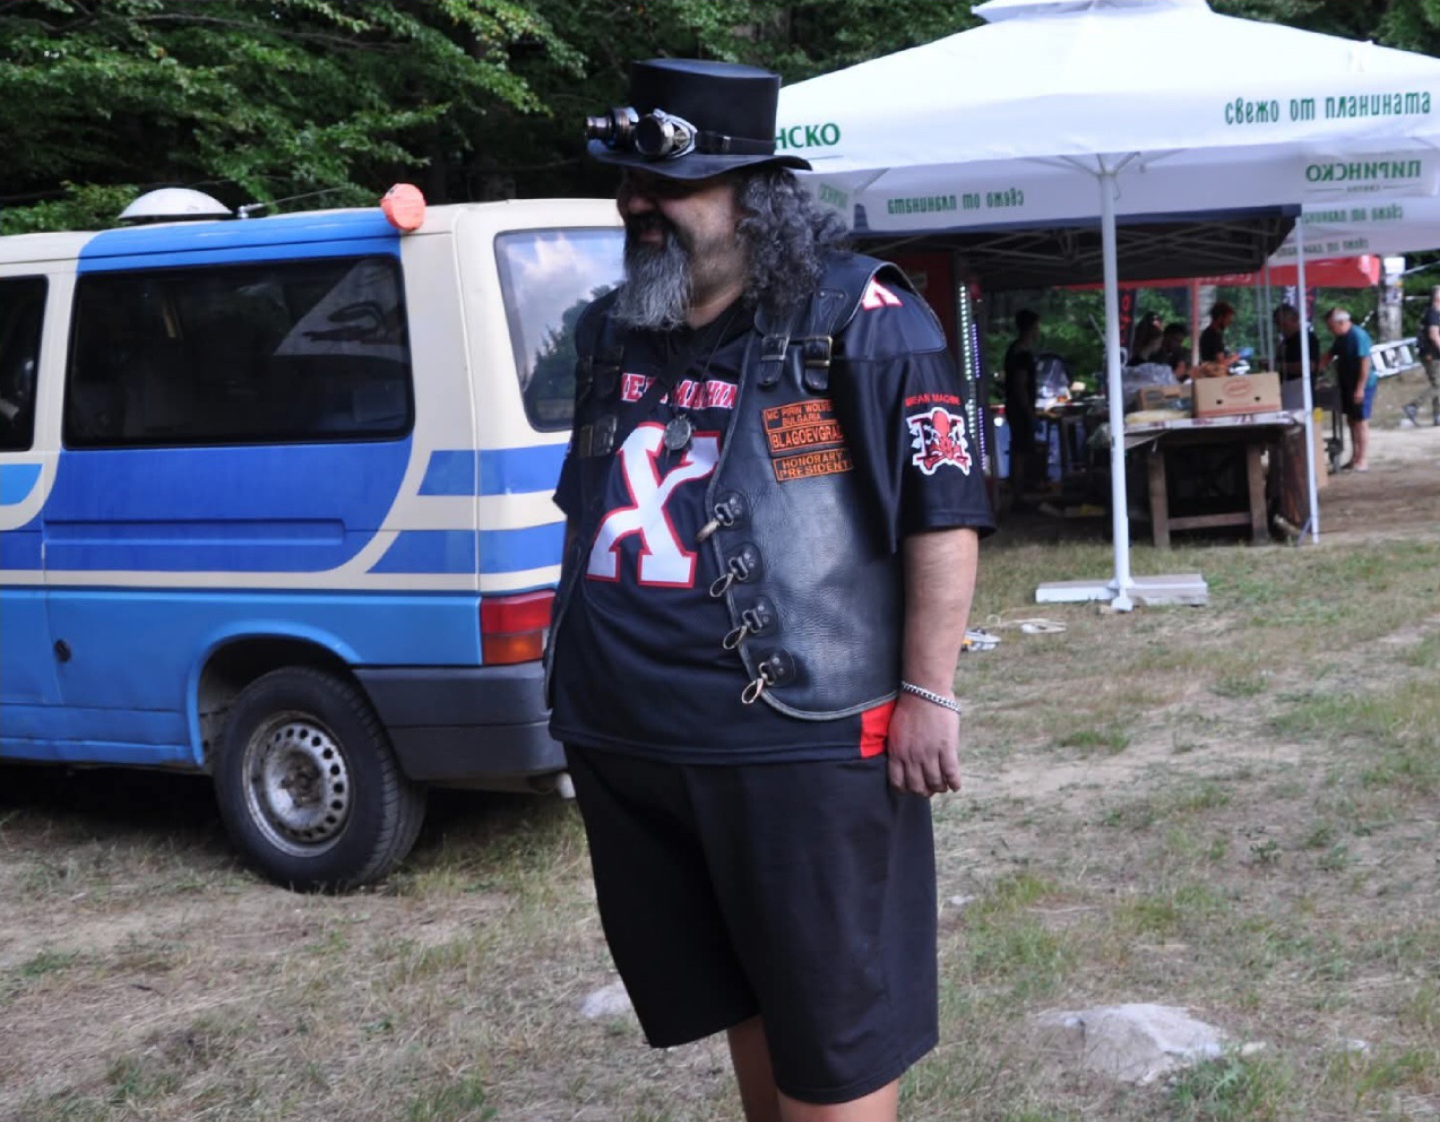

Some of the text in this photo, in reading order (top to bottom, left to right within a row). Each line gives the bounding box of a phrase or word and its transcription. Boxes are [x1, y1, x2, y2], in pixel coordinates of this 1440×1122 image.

[1224, 90, 1432, 126] свежо от планината
[775, 122, 841, 150] НСКО
[782, 413, 821, 428] BULGARIA
[782, 451, 844, 469] HONORARY
[779, 461, 850, 478] PRESIDENT
